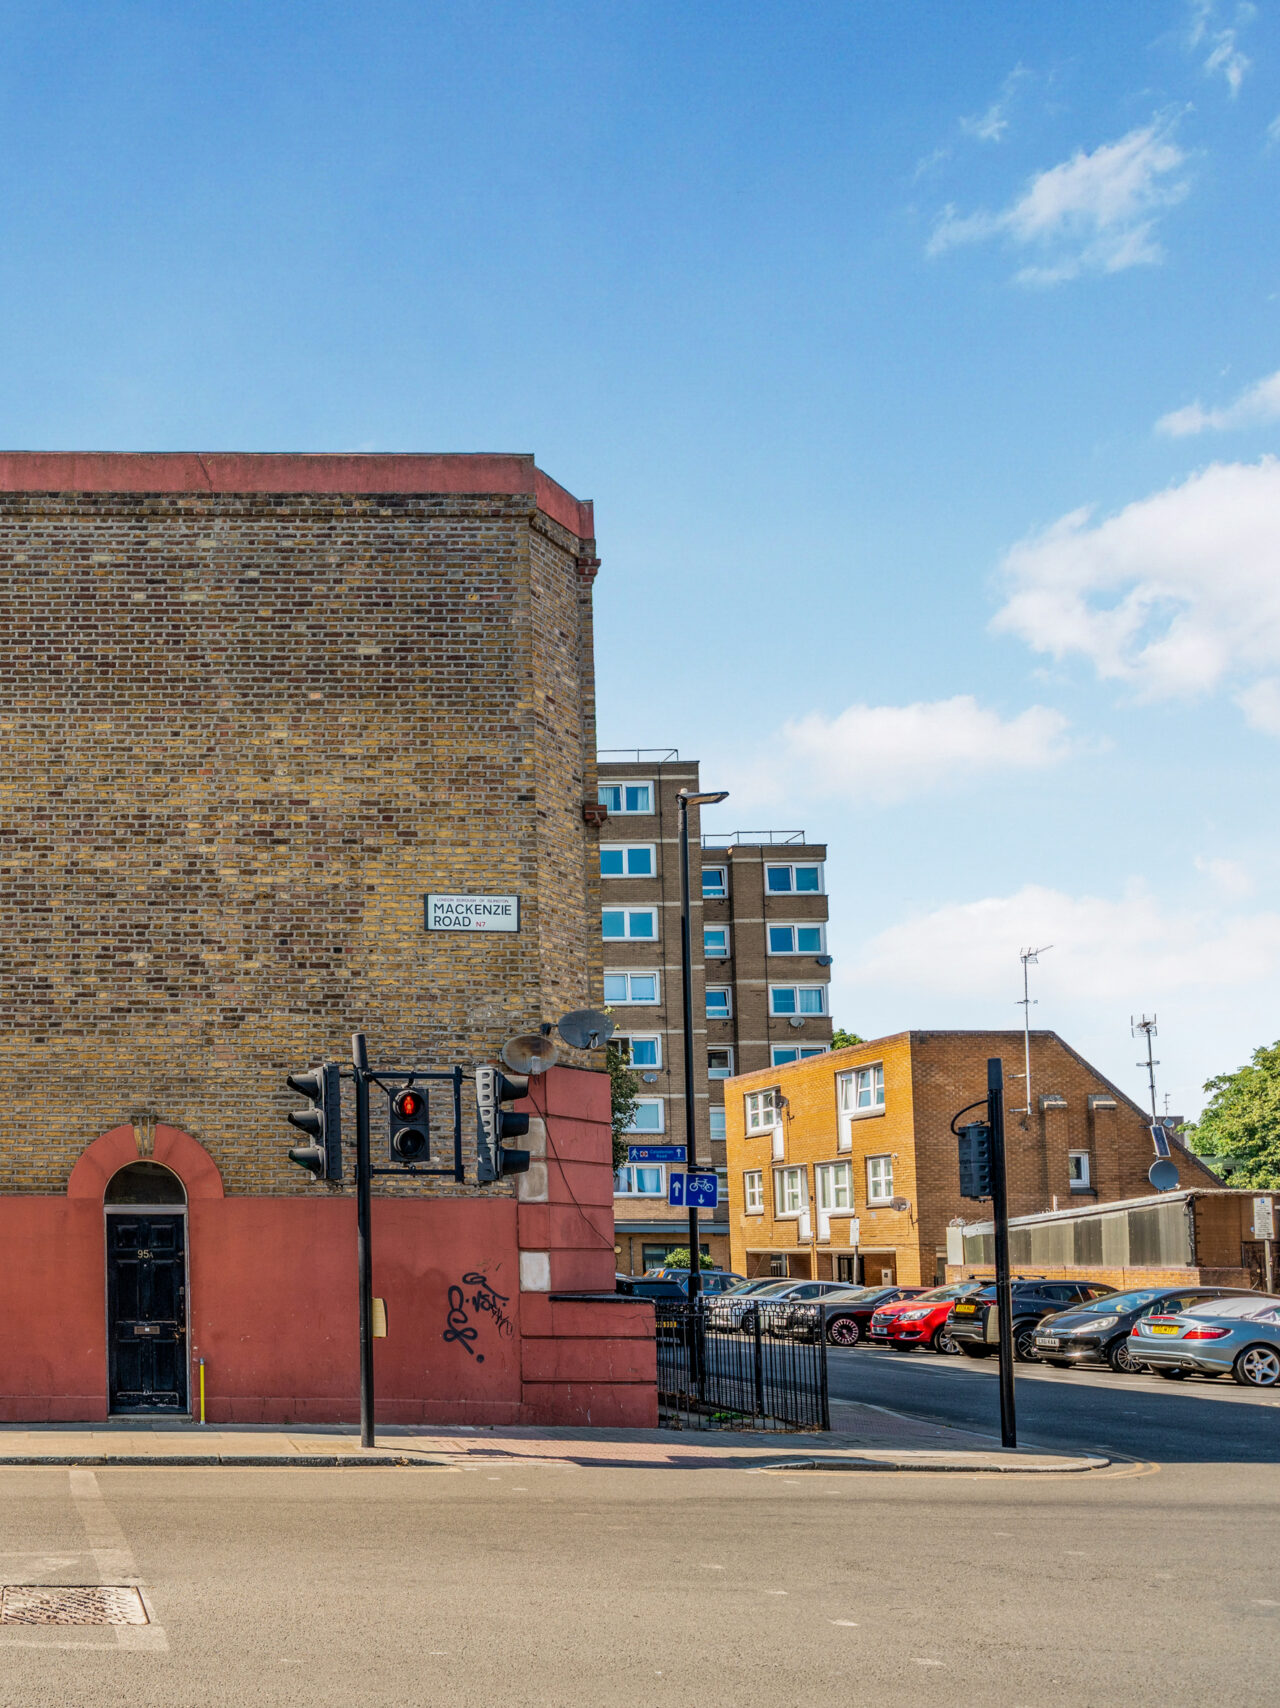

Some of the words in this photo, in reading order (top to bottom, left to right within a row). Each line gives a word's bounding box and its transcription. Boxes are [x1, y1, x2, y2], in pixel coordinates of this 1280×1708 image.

[433, 903, 512, 916] MACKENZIE
[433, 915, 471, 927] ROAD
[137, 1249, 154, 1259] 95A
